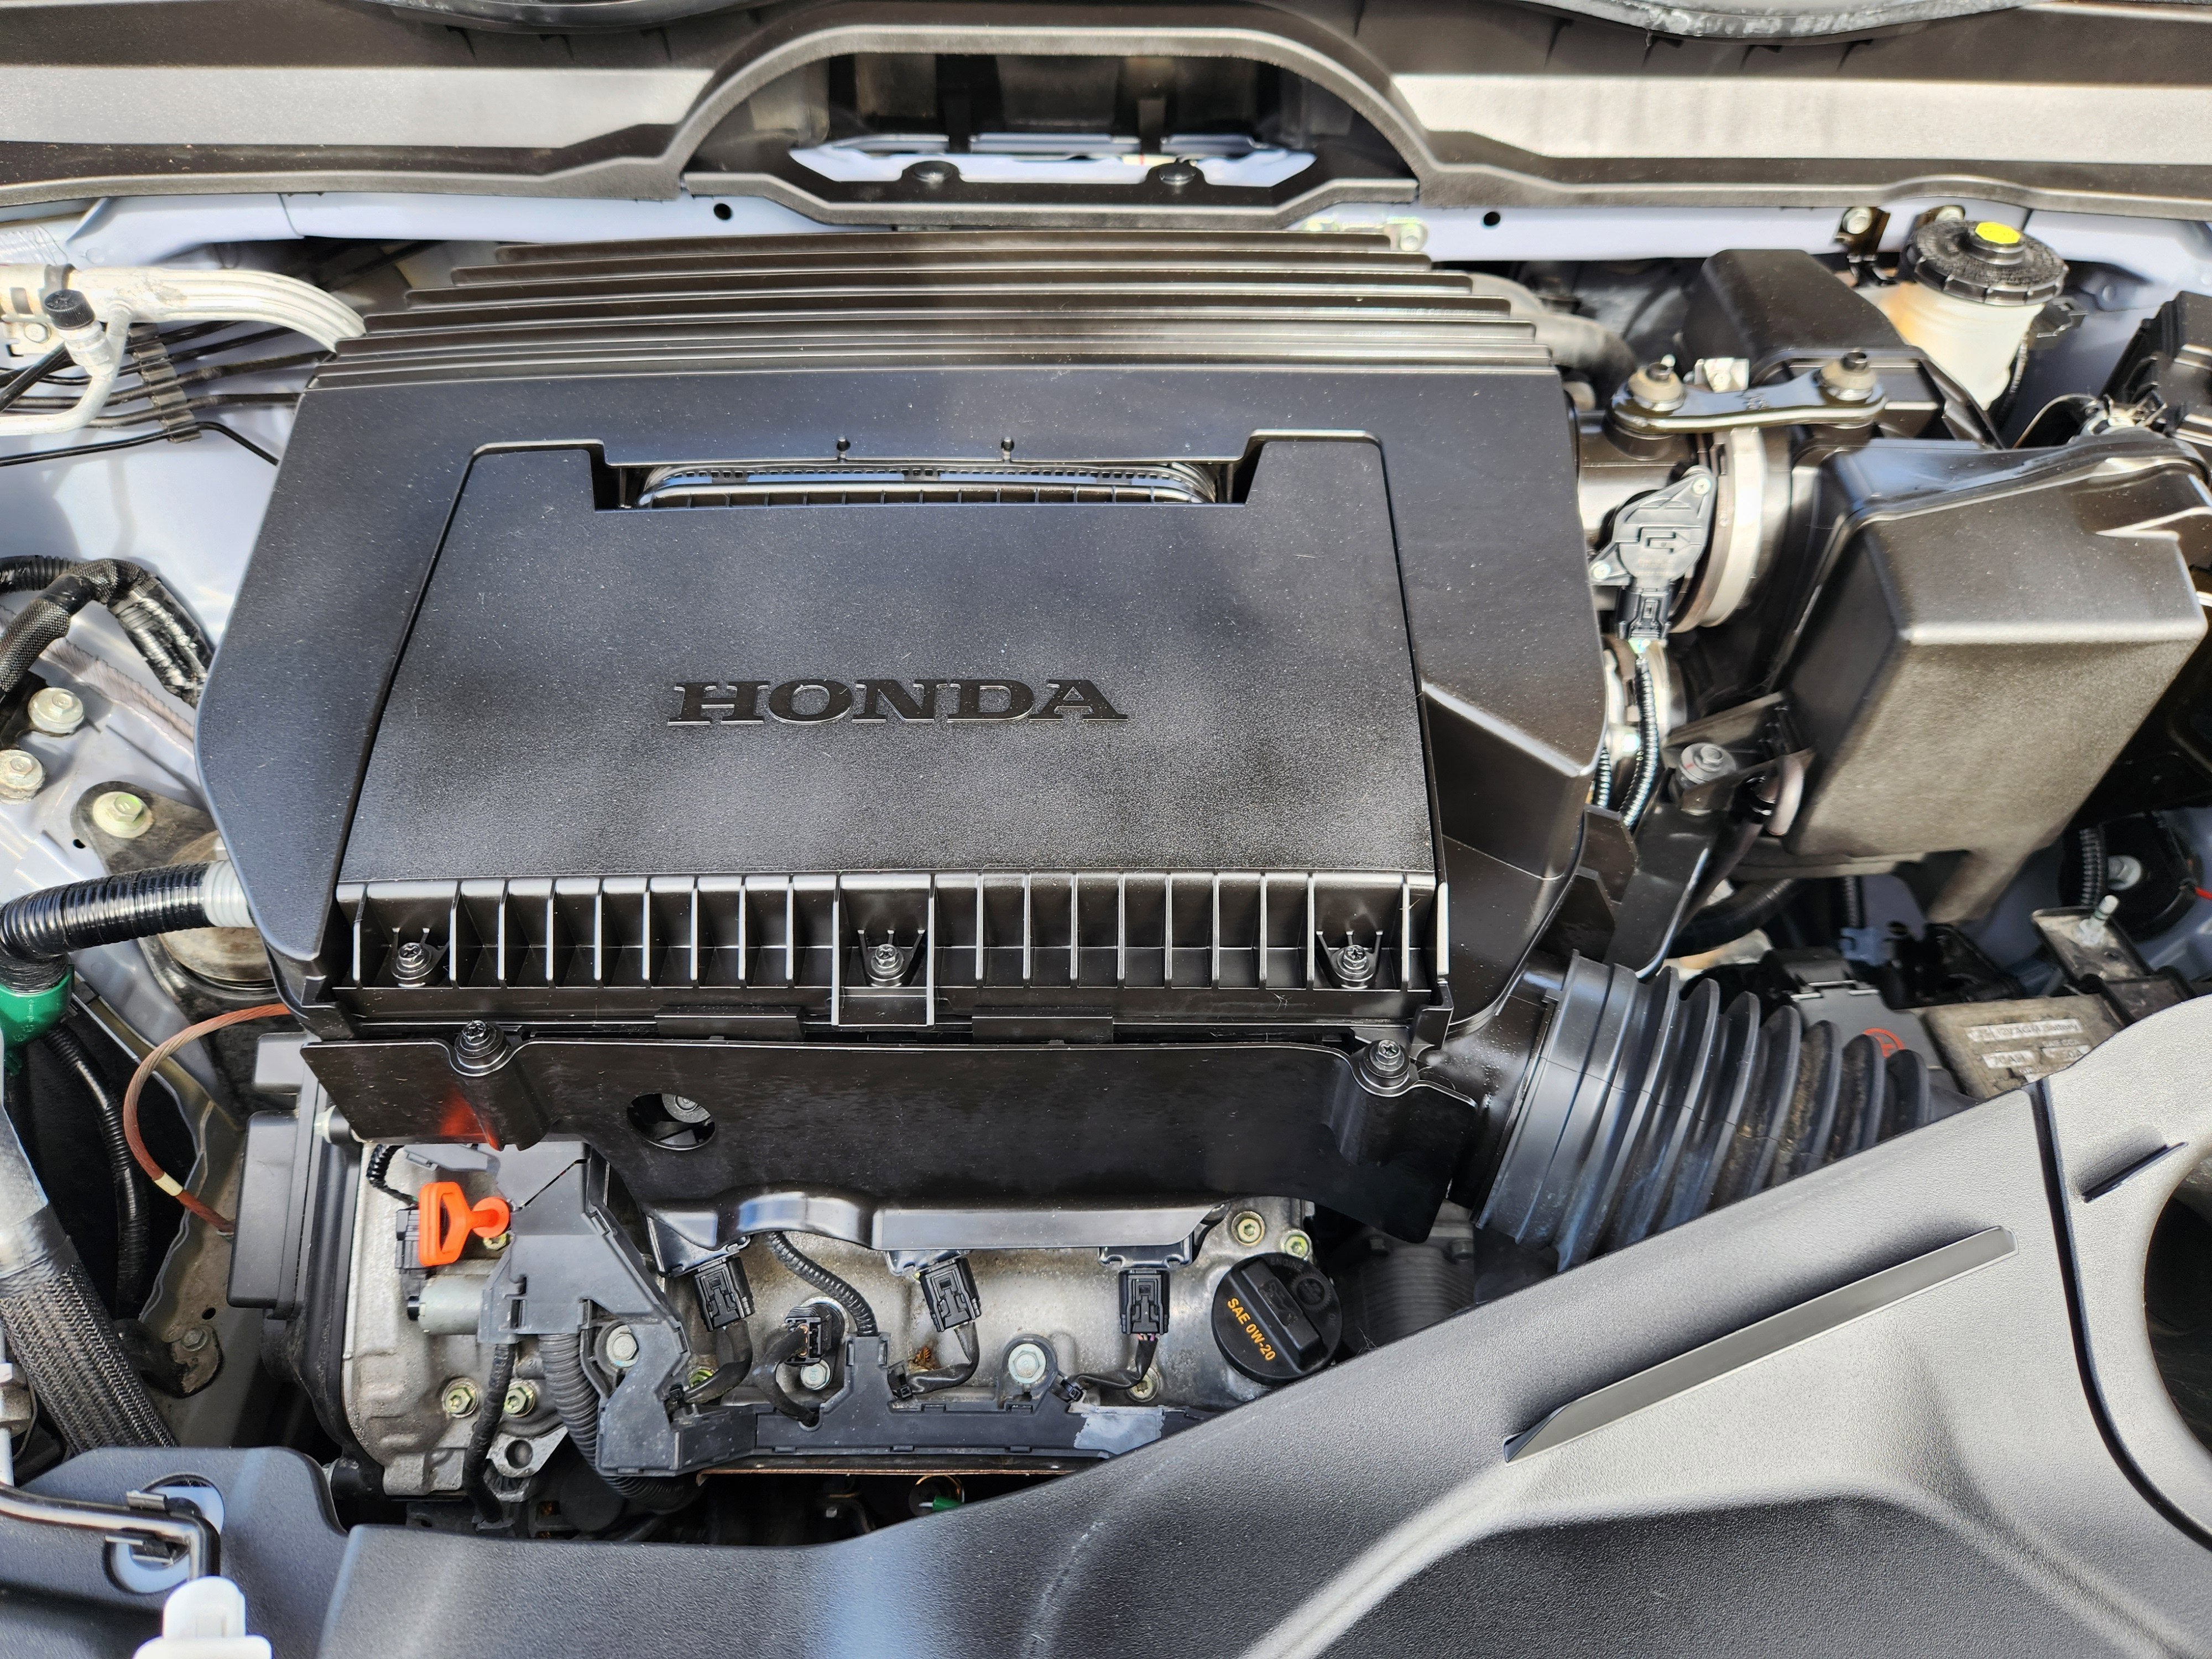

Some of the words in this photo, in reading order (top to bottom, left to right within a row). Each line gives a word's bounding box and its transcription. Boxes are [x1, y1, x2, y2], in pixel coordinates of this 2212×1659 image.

[668, 678, 1129, 725] HONDA
[1227, 1297, 1251, 1325] SAE
[1246, 1323, 1276, 1361] 0W-20
